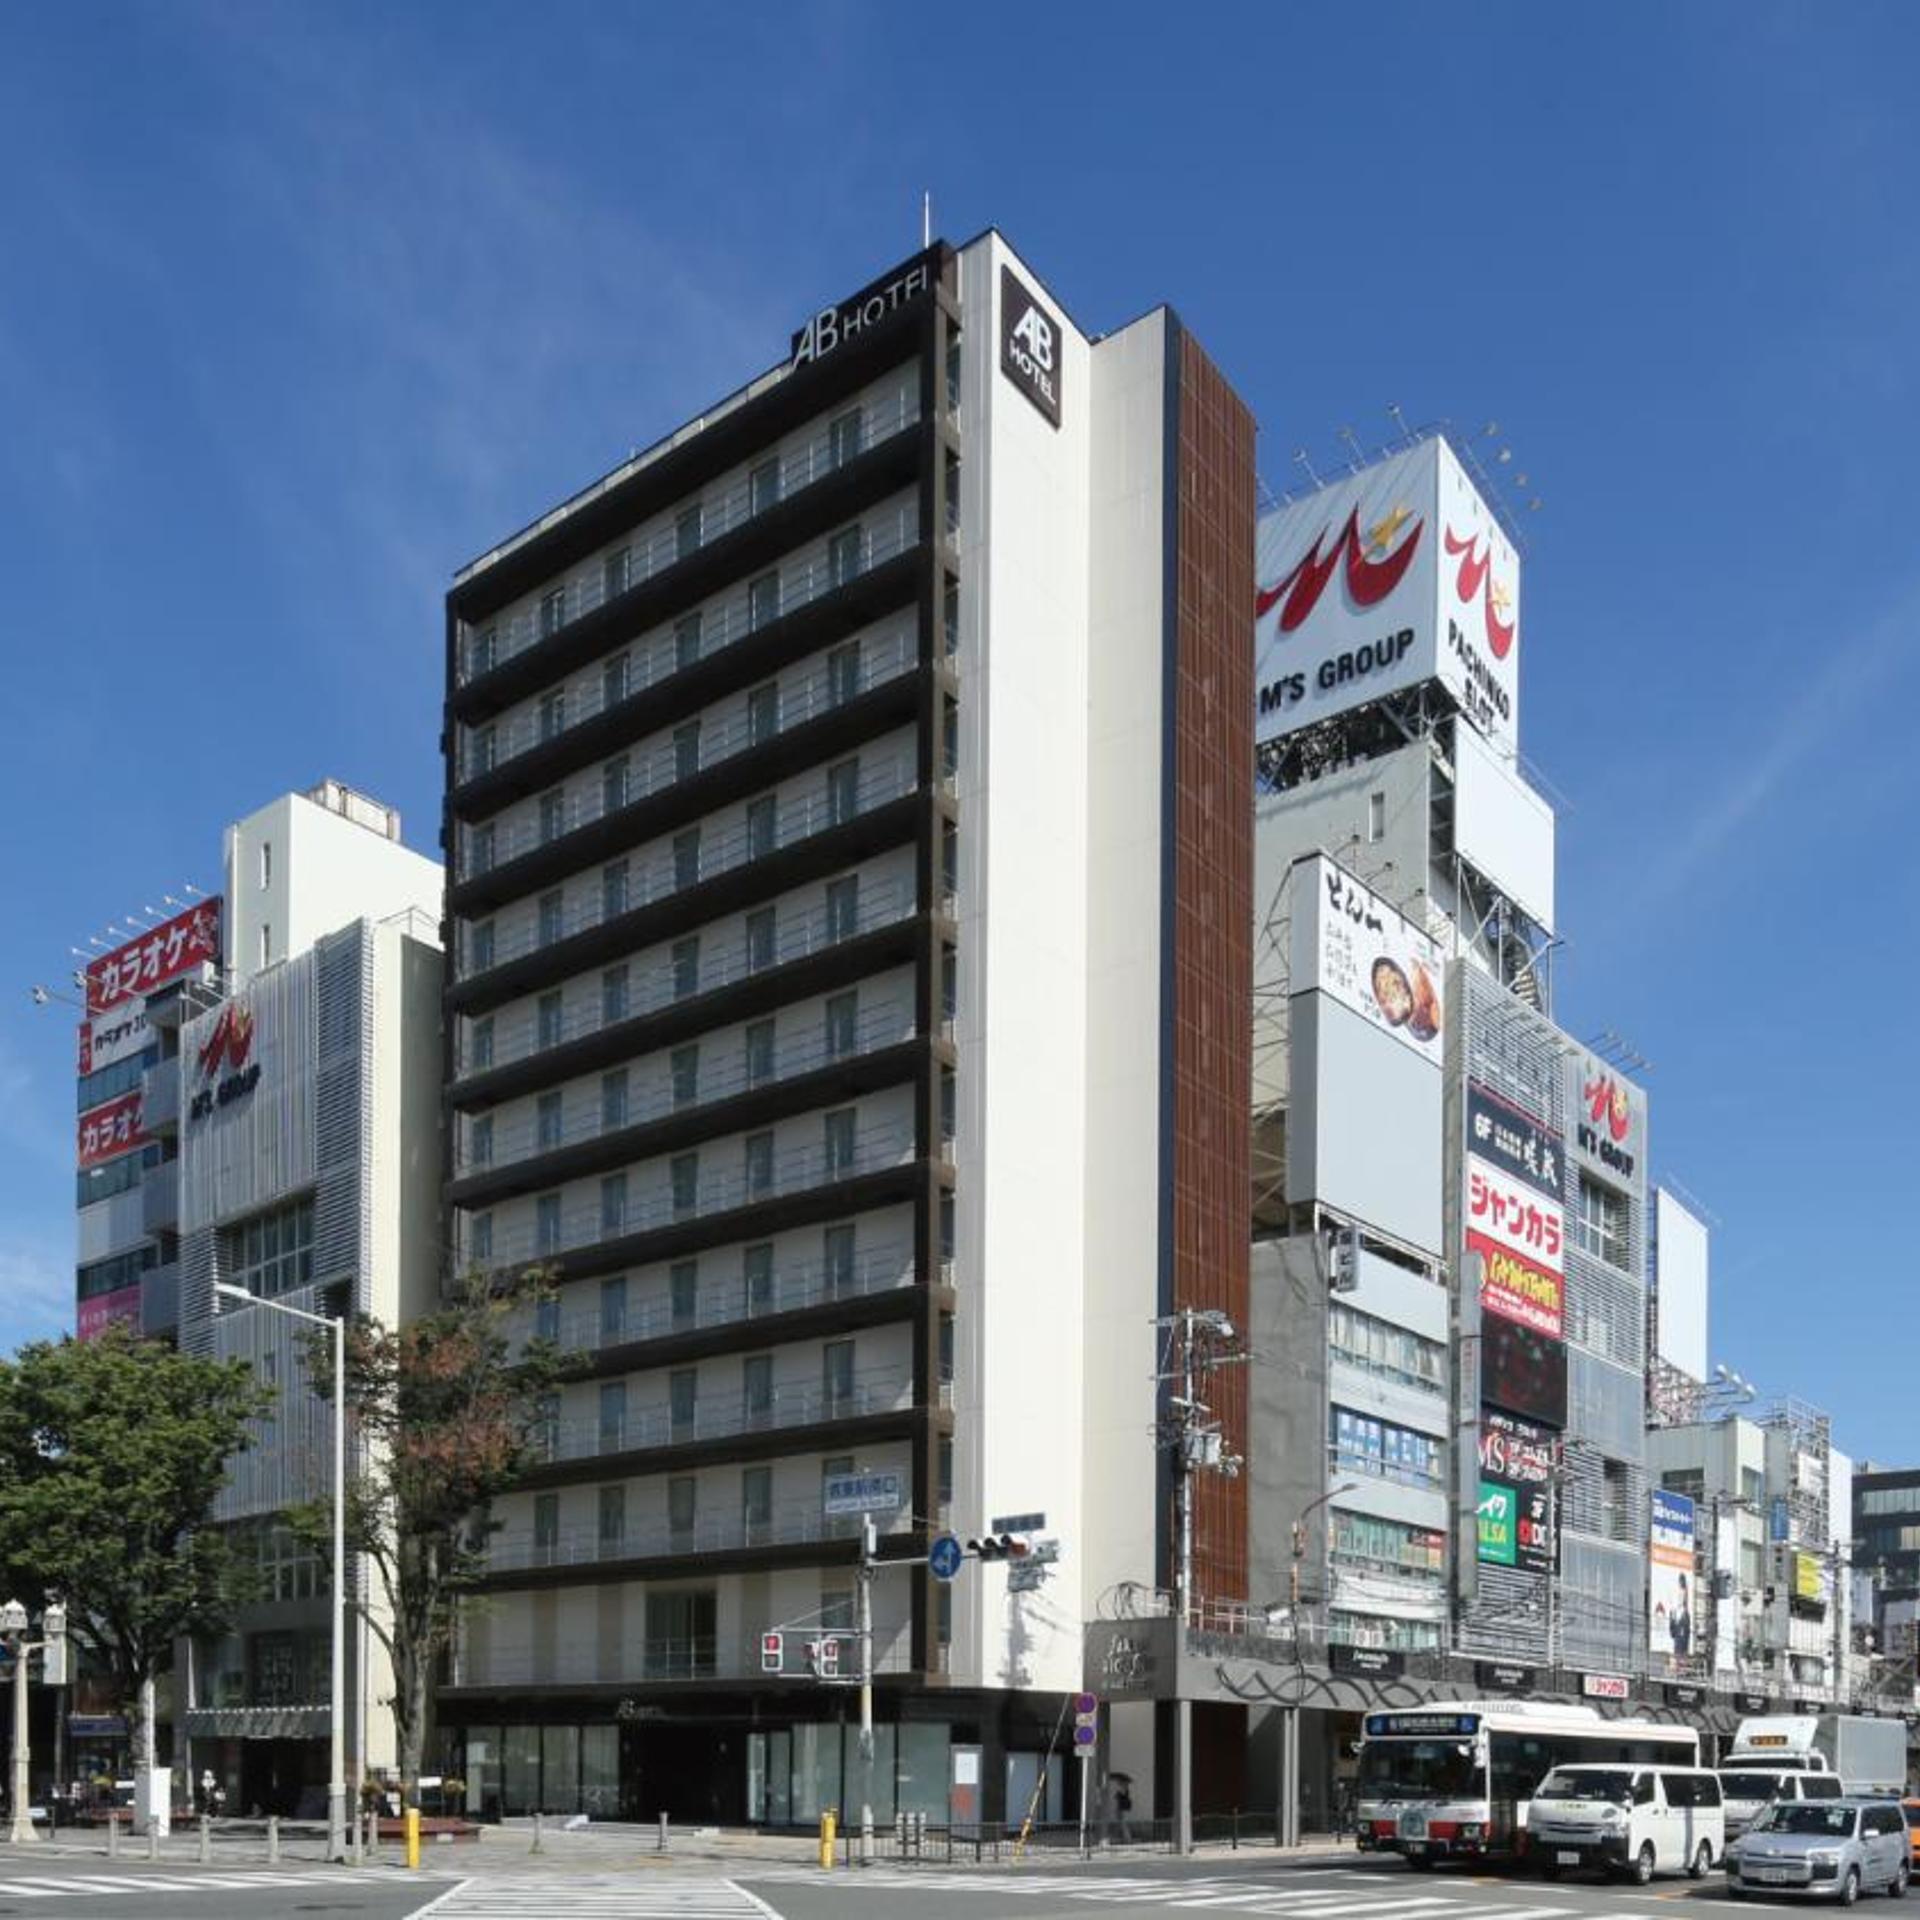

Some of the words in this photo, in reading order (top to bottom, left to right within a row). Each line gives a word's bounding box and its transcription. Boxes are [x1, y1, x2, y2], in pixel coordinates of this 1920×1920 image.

[791, 306, 839, 369] AB
[1010, 339, 1055, 405] HOTEL
[1013, 306, 1052, 371] AB
[1260, 672, 1305, 714] M'S
[1318, 628, 1415, 690] GROUP
[1448, 618, 1510, 721] PACHINKO
[1471, 1173, 1560, 1255] ジャンカラ
